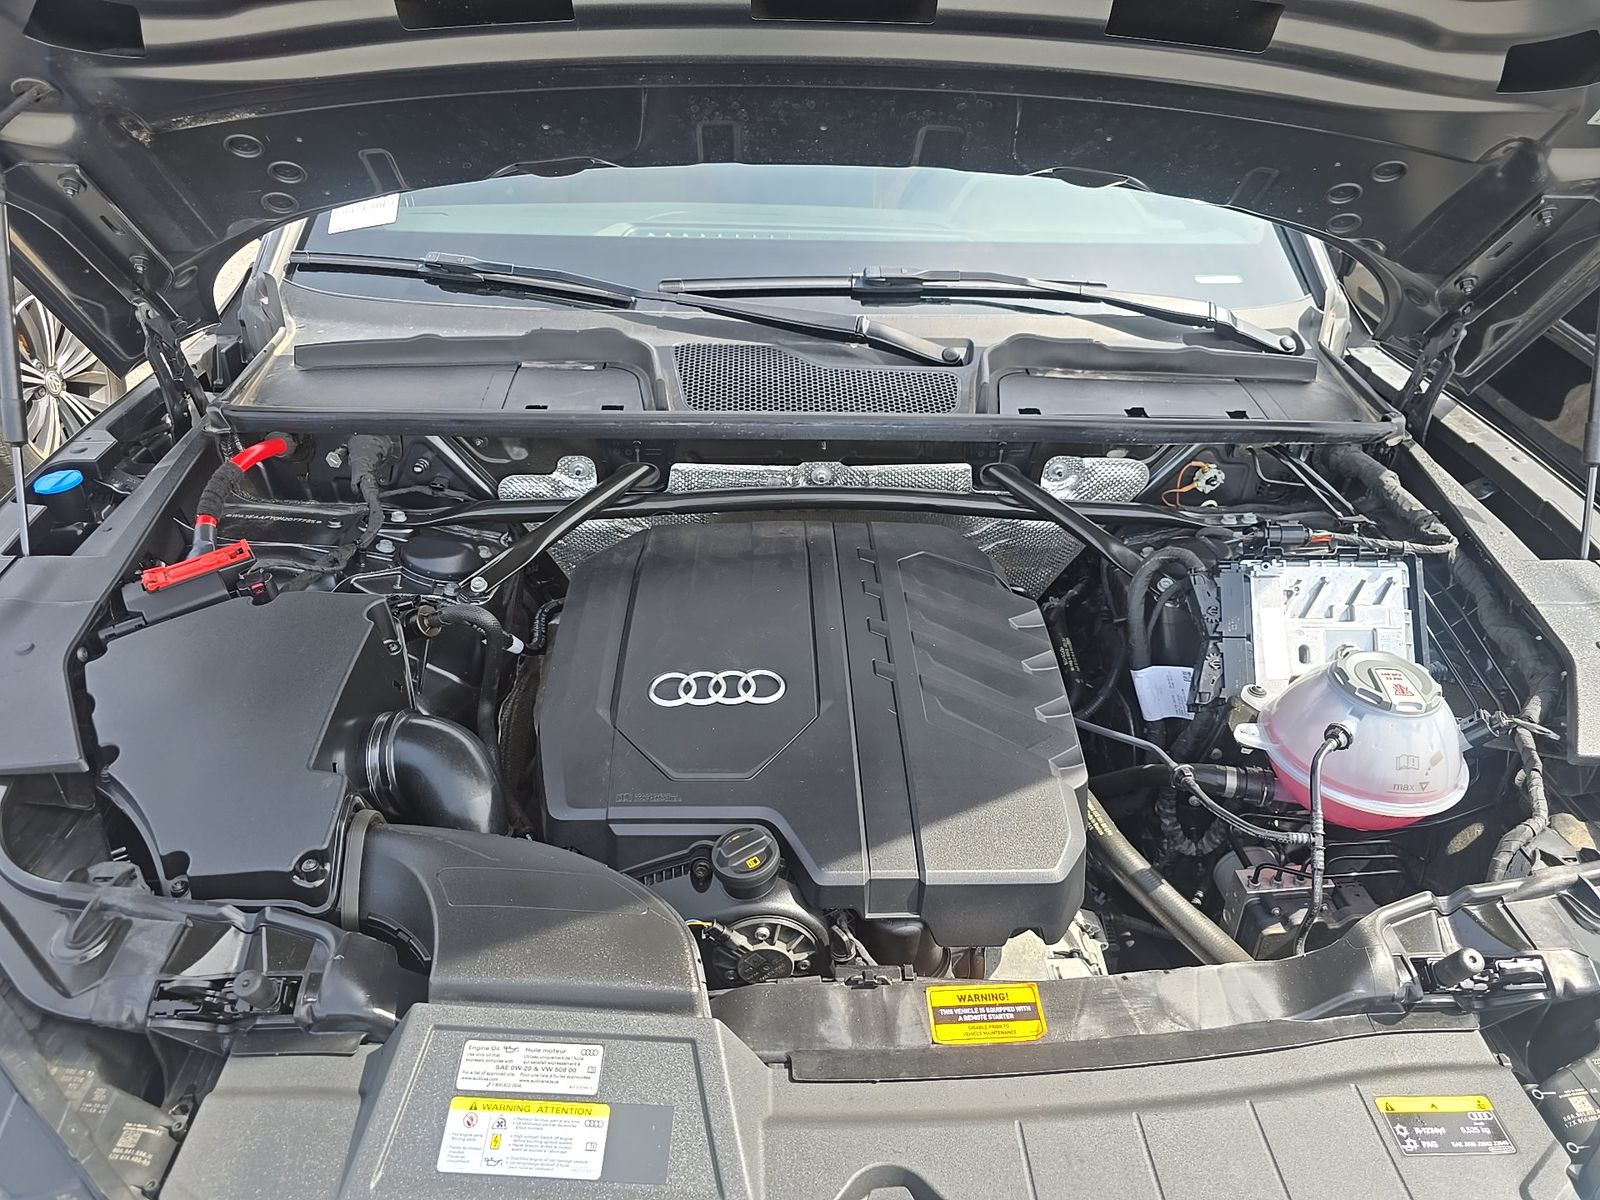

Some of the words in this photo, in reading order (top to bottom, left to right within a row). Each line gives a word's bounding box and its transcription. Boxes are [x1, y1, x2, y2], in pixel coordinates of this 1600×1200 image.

[1393, 783, 1415, 791] max
[957, 992, 1009, 1002] WARNING!
[939, 1007, 954, 1015] THIS
[954, 1007, 979, 1015] VEHICLE
[482, 1104, 530, 1113] WARNING
[536, 1106, 592, 1115] ATTENTION
[1479, 1126, 1491, 1135] kg
[1420, 1140, 1438, 1149] PAG
